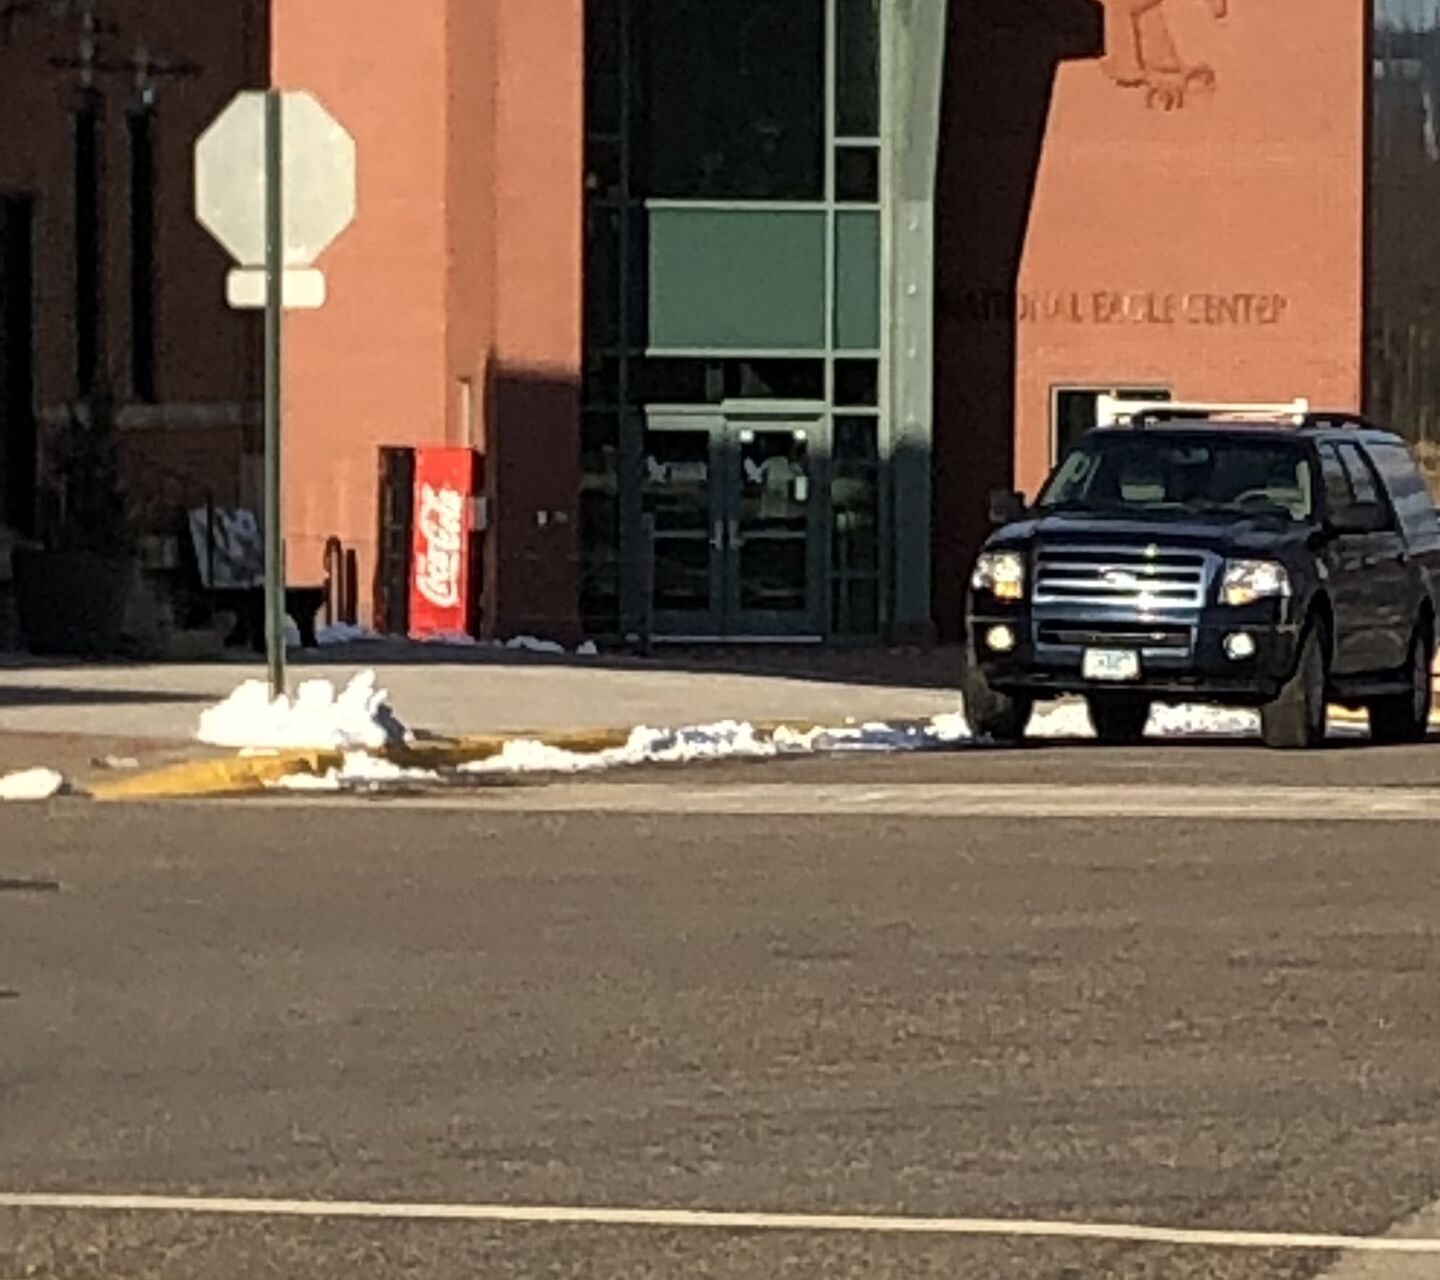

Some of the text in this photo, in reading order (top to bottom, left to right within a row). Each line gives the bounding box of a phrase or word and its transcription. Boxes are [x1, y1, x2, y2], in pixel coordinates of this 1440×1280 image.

[946, 292, 1289, 325] TIONAL EAGLE CENTER
